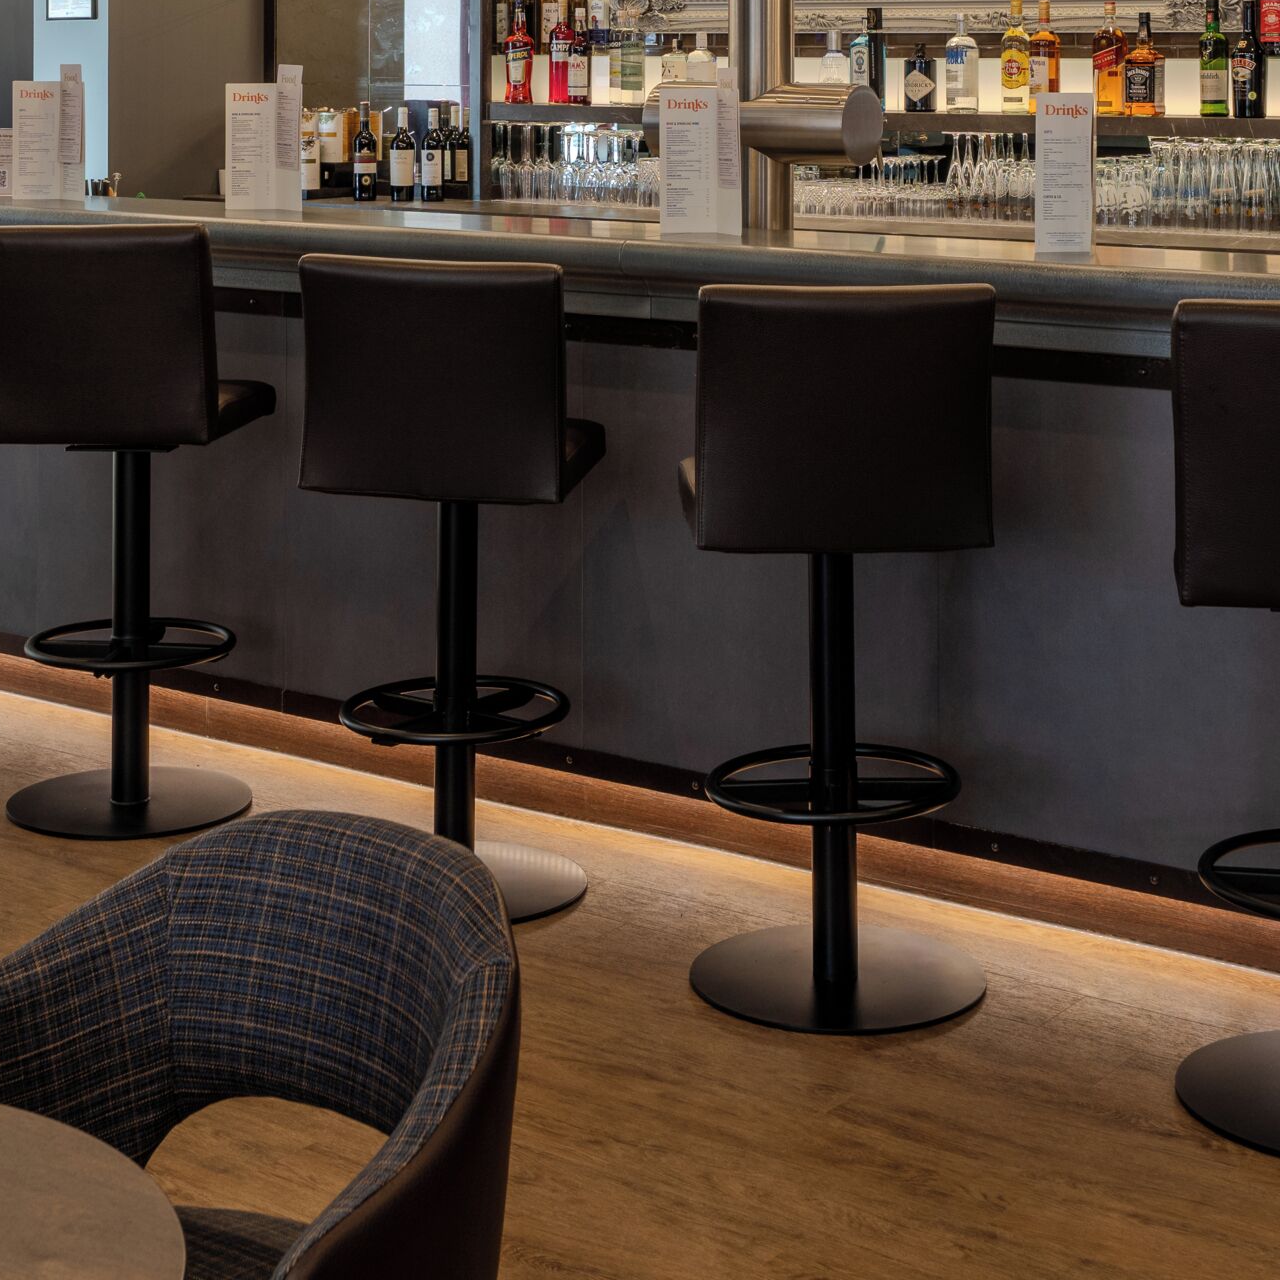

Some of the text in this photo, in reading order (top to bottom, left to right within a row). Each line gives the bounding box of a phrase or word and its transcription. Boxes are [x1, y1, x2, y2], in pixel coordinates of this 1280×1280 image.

[20, 89, 55, 101] Drinks
[232, 92, 269, 104] Drinks
[667, 99, 708, 112] Drinks
[1045, 104, 1088, 118] Drinks
